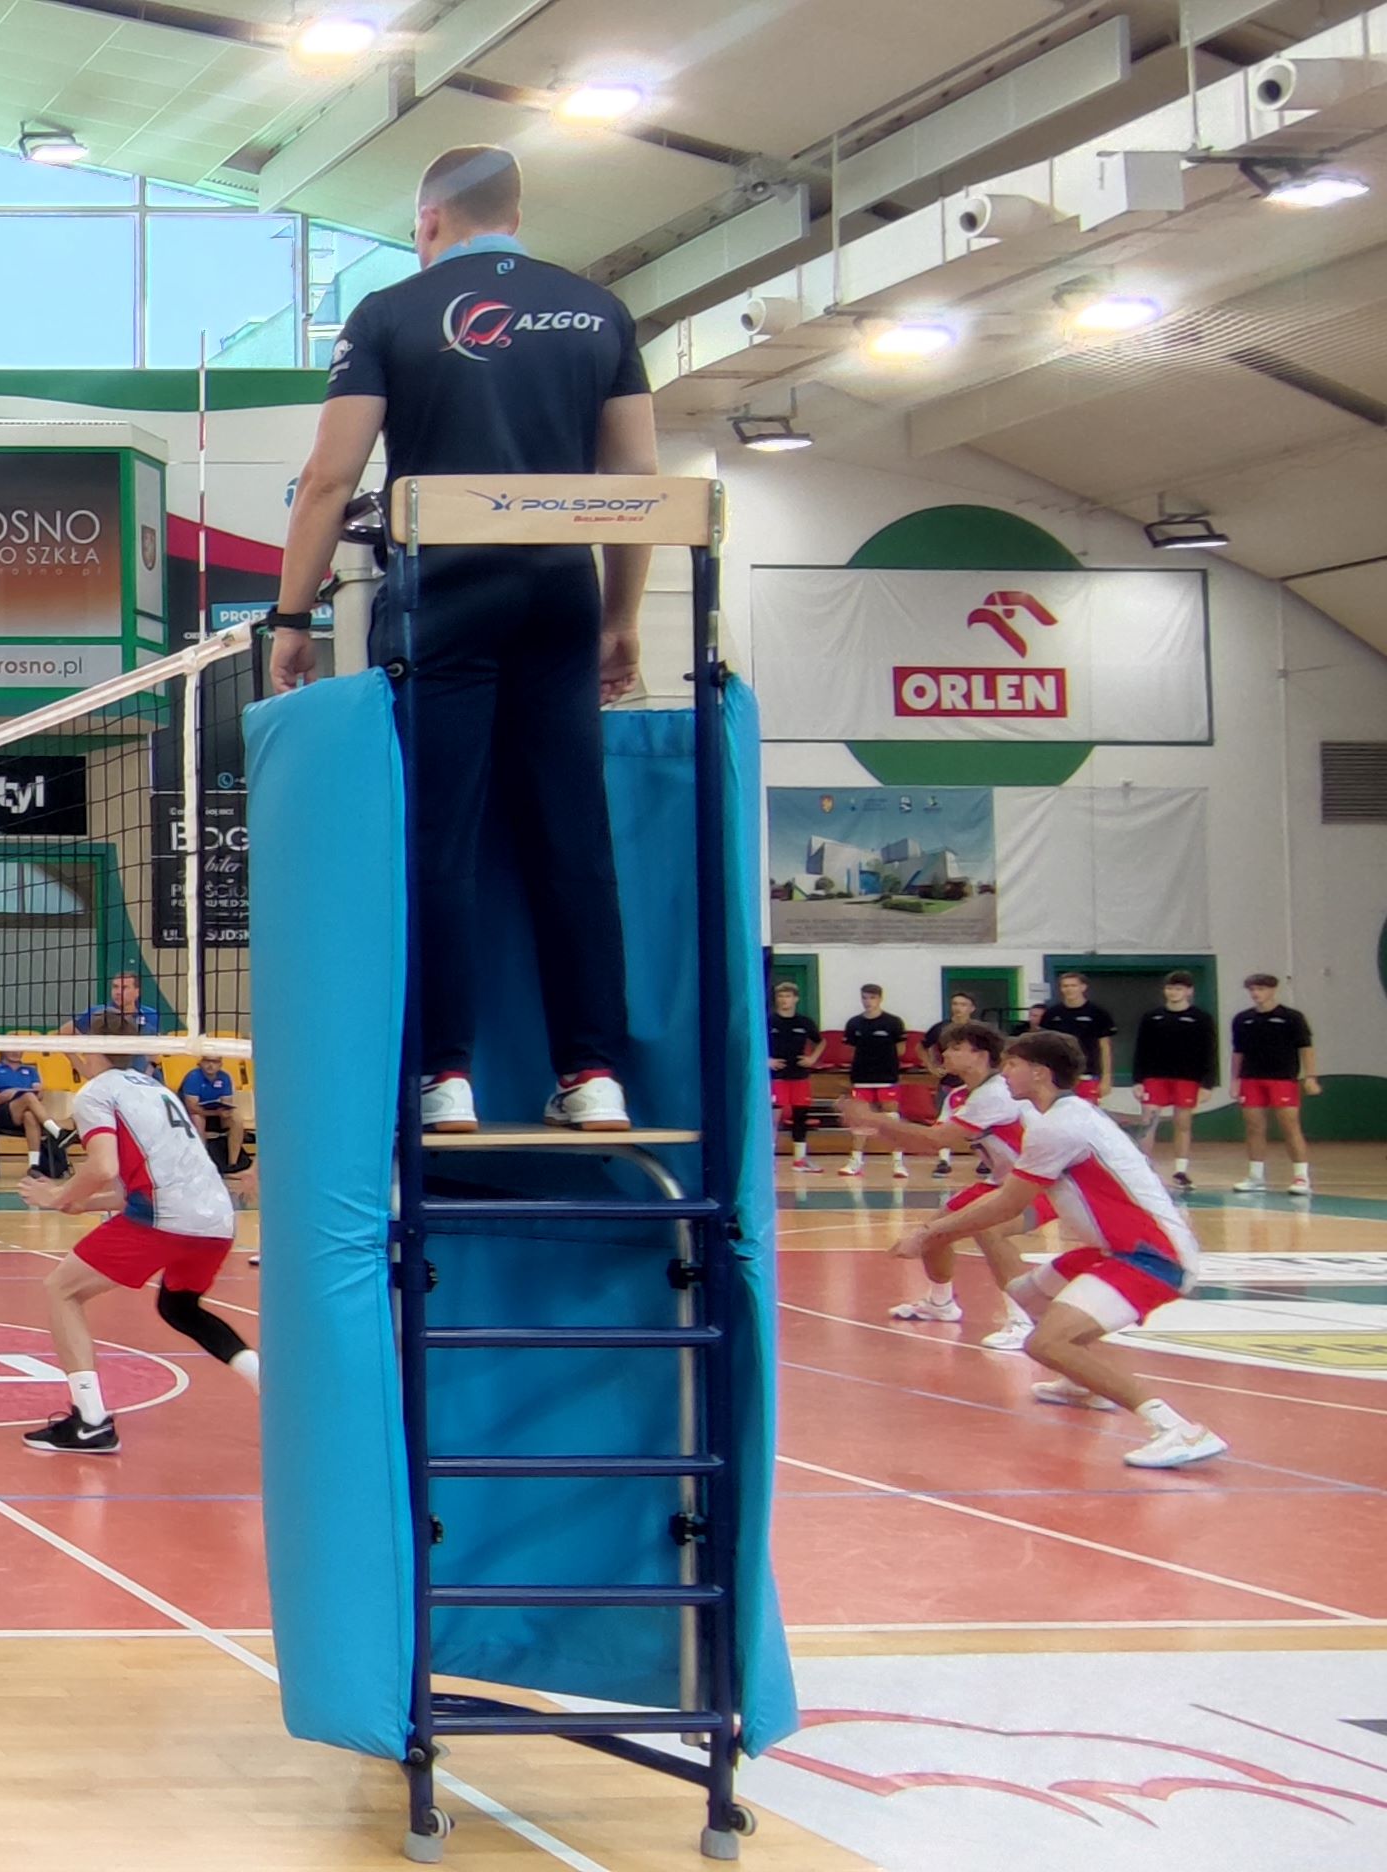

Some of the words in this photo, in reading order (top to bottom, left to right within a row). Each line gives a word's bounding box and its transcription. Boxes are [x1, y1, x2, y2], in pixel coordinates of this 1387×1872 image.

[514, 311, 605, 332] AZGOT
[521, 499, 659, 514] POLSPORT
[26, 546, 100, 564] SZKŁA
[901, 673, 1057, 711] ORLEN
[161, 1094, 196, 1139] 4
